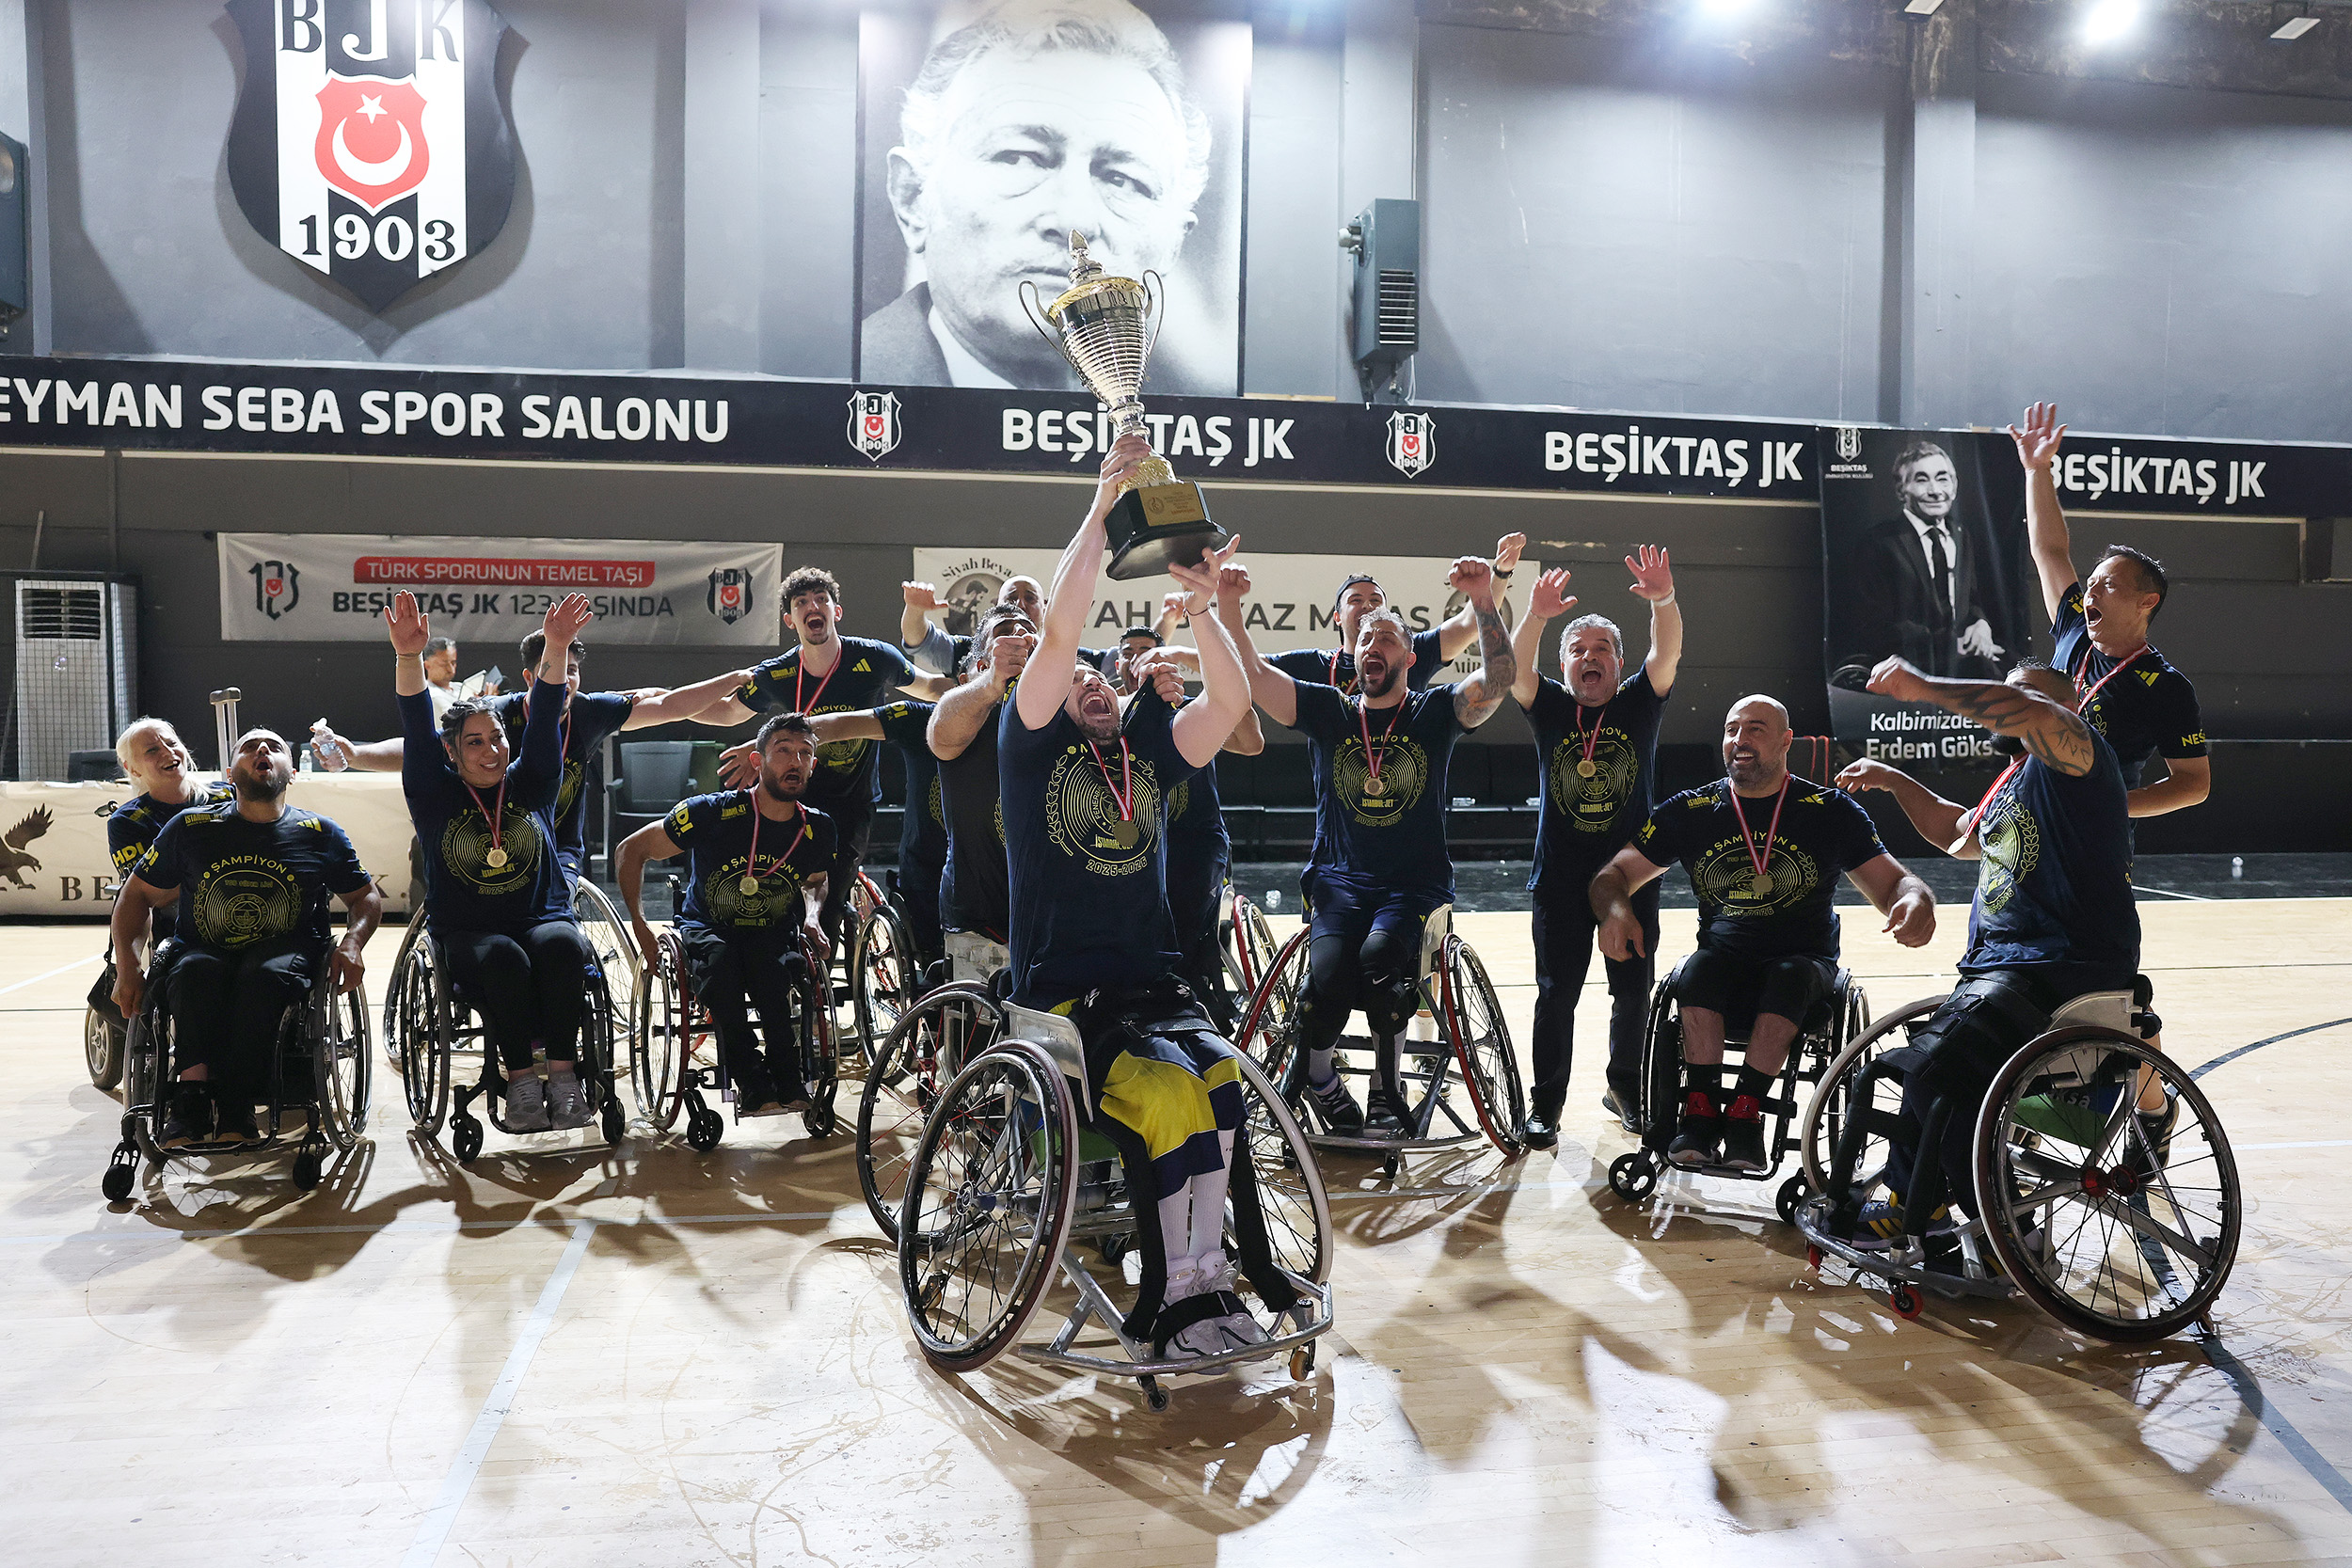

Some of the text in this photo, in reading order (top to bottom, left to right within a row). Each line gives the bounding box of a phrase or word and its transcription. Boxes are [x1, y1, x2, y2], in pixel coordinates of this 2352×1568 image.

[298, 214, 455, 261] 1903
[201, 385, 345, 434] SEBA
[359, 389, 505, 437] SPOR
[520, 394, 729, 443] SALONU
[858, 399, 891, 414] BJK
[1002, 403, 1295, 467] BEŞİTAŞ JK
[1396, 419, 1425, 433] BJK
[861, 440, 890, 451] 1903
[1545, 425, 1804, 488] BEŞİKTAŞ JK
[1398, 458, 1425, 468] 1903
[2225, 460, 2266, 505] JK
[367, 558, 644, 585] TÜRK SPORUNUN TEMEL TAŞI
[942, 557, 978, 581] Siyah
[333, 587, 464, 618] BEŞİTAŞ
[469, 593, 500, 614] JK
[510, 594, 553, 615] 123
[808, 704, 855, 717] AMPİYON
[1870, 709, 1988, 732] Kalbimizdes
[1866, 736, 1937, 760] Erdem
[1714, 830, 1788, 852] ŞAMİYN
[112, 842, 146, 867] HDI
[211, 854, 288, 874] ŞAMPİYON
[1086, 855, 1148, 877] 2025-2026
